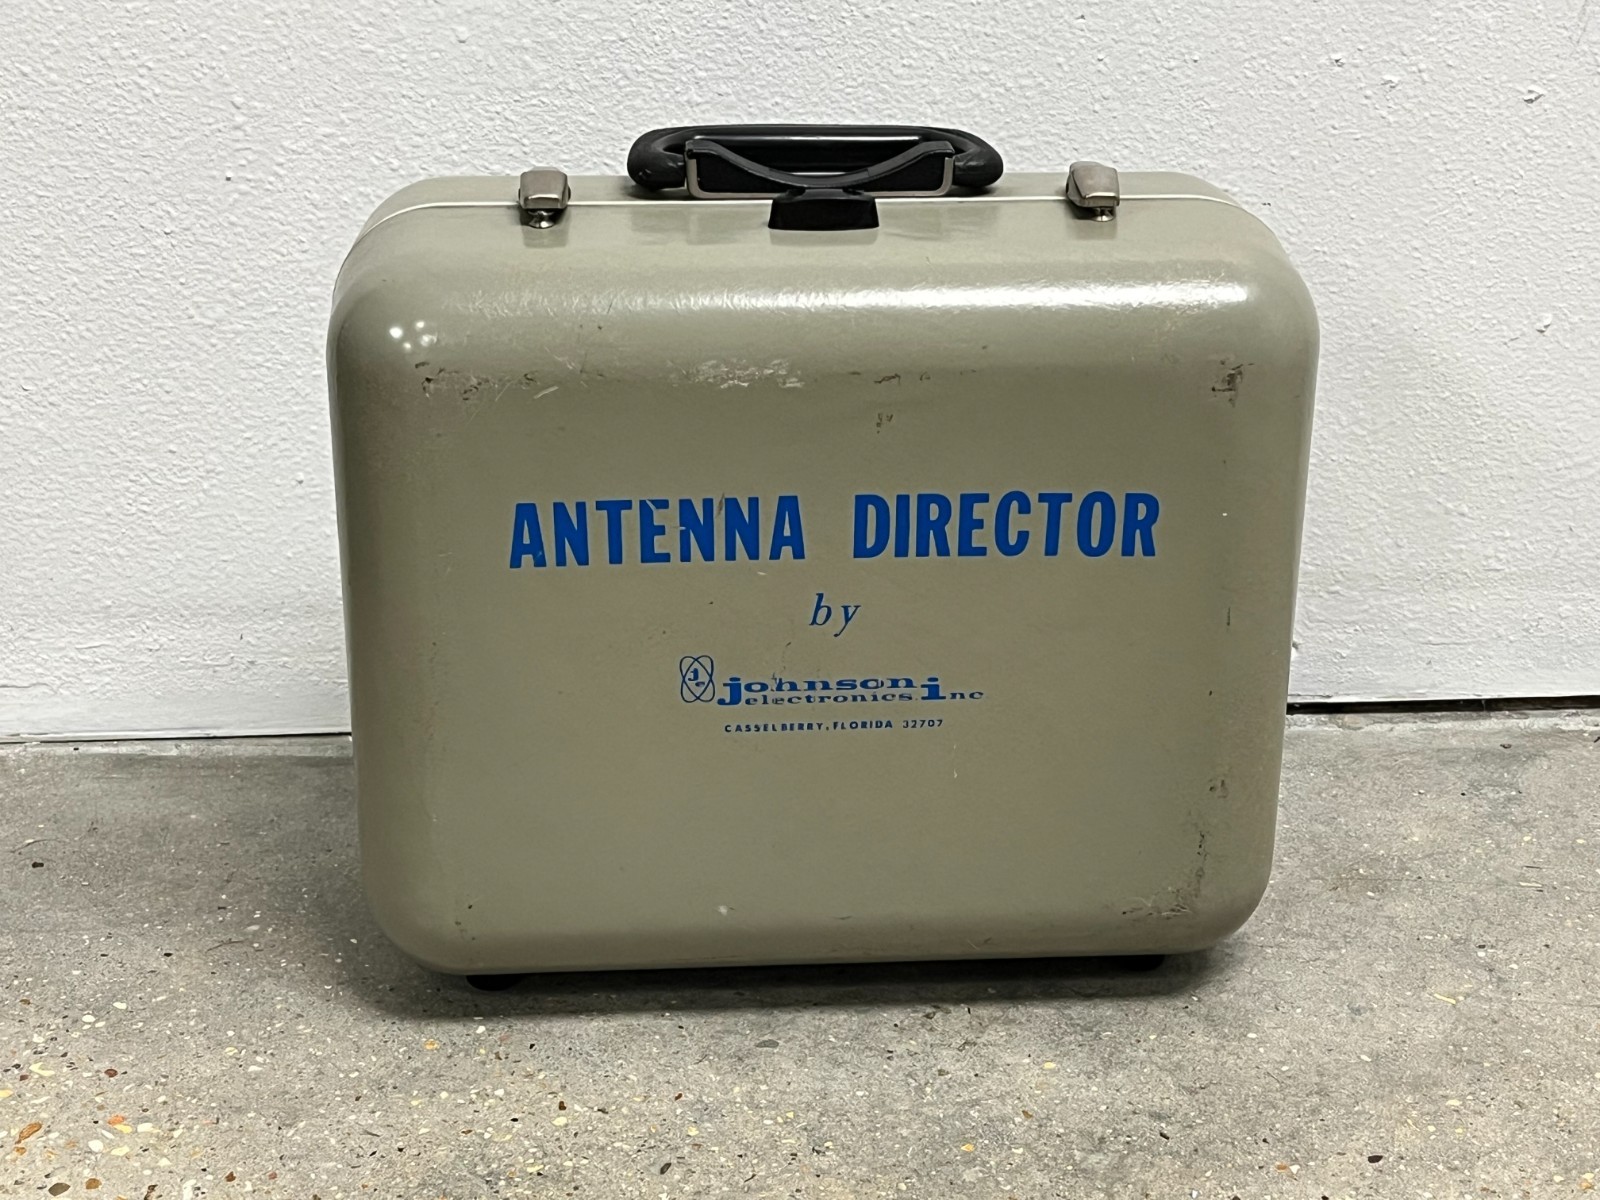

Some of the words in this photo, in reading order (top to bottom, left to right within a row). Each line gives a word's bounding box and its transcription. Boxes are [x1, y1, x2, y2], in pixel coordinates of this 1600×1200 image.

[508, 492, 807, 570] ANTENNA
[852, 489, 1162, 560] DIRECTOR
[809, 591, 861, 637] by
[716, 676, 917, 706] johnson
[902, 719, 944, 729] 32707
